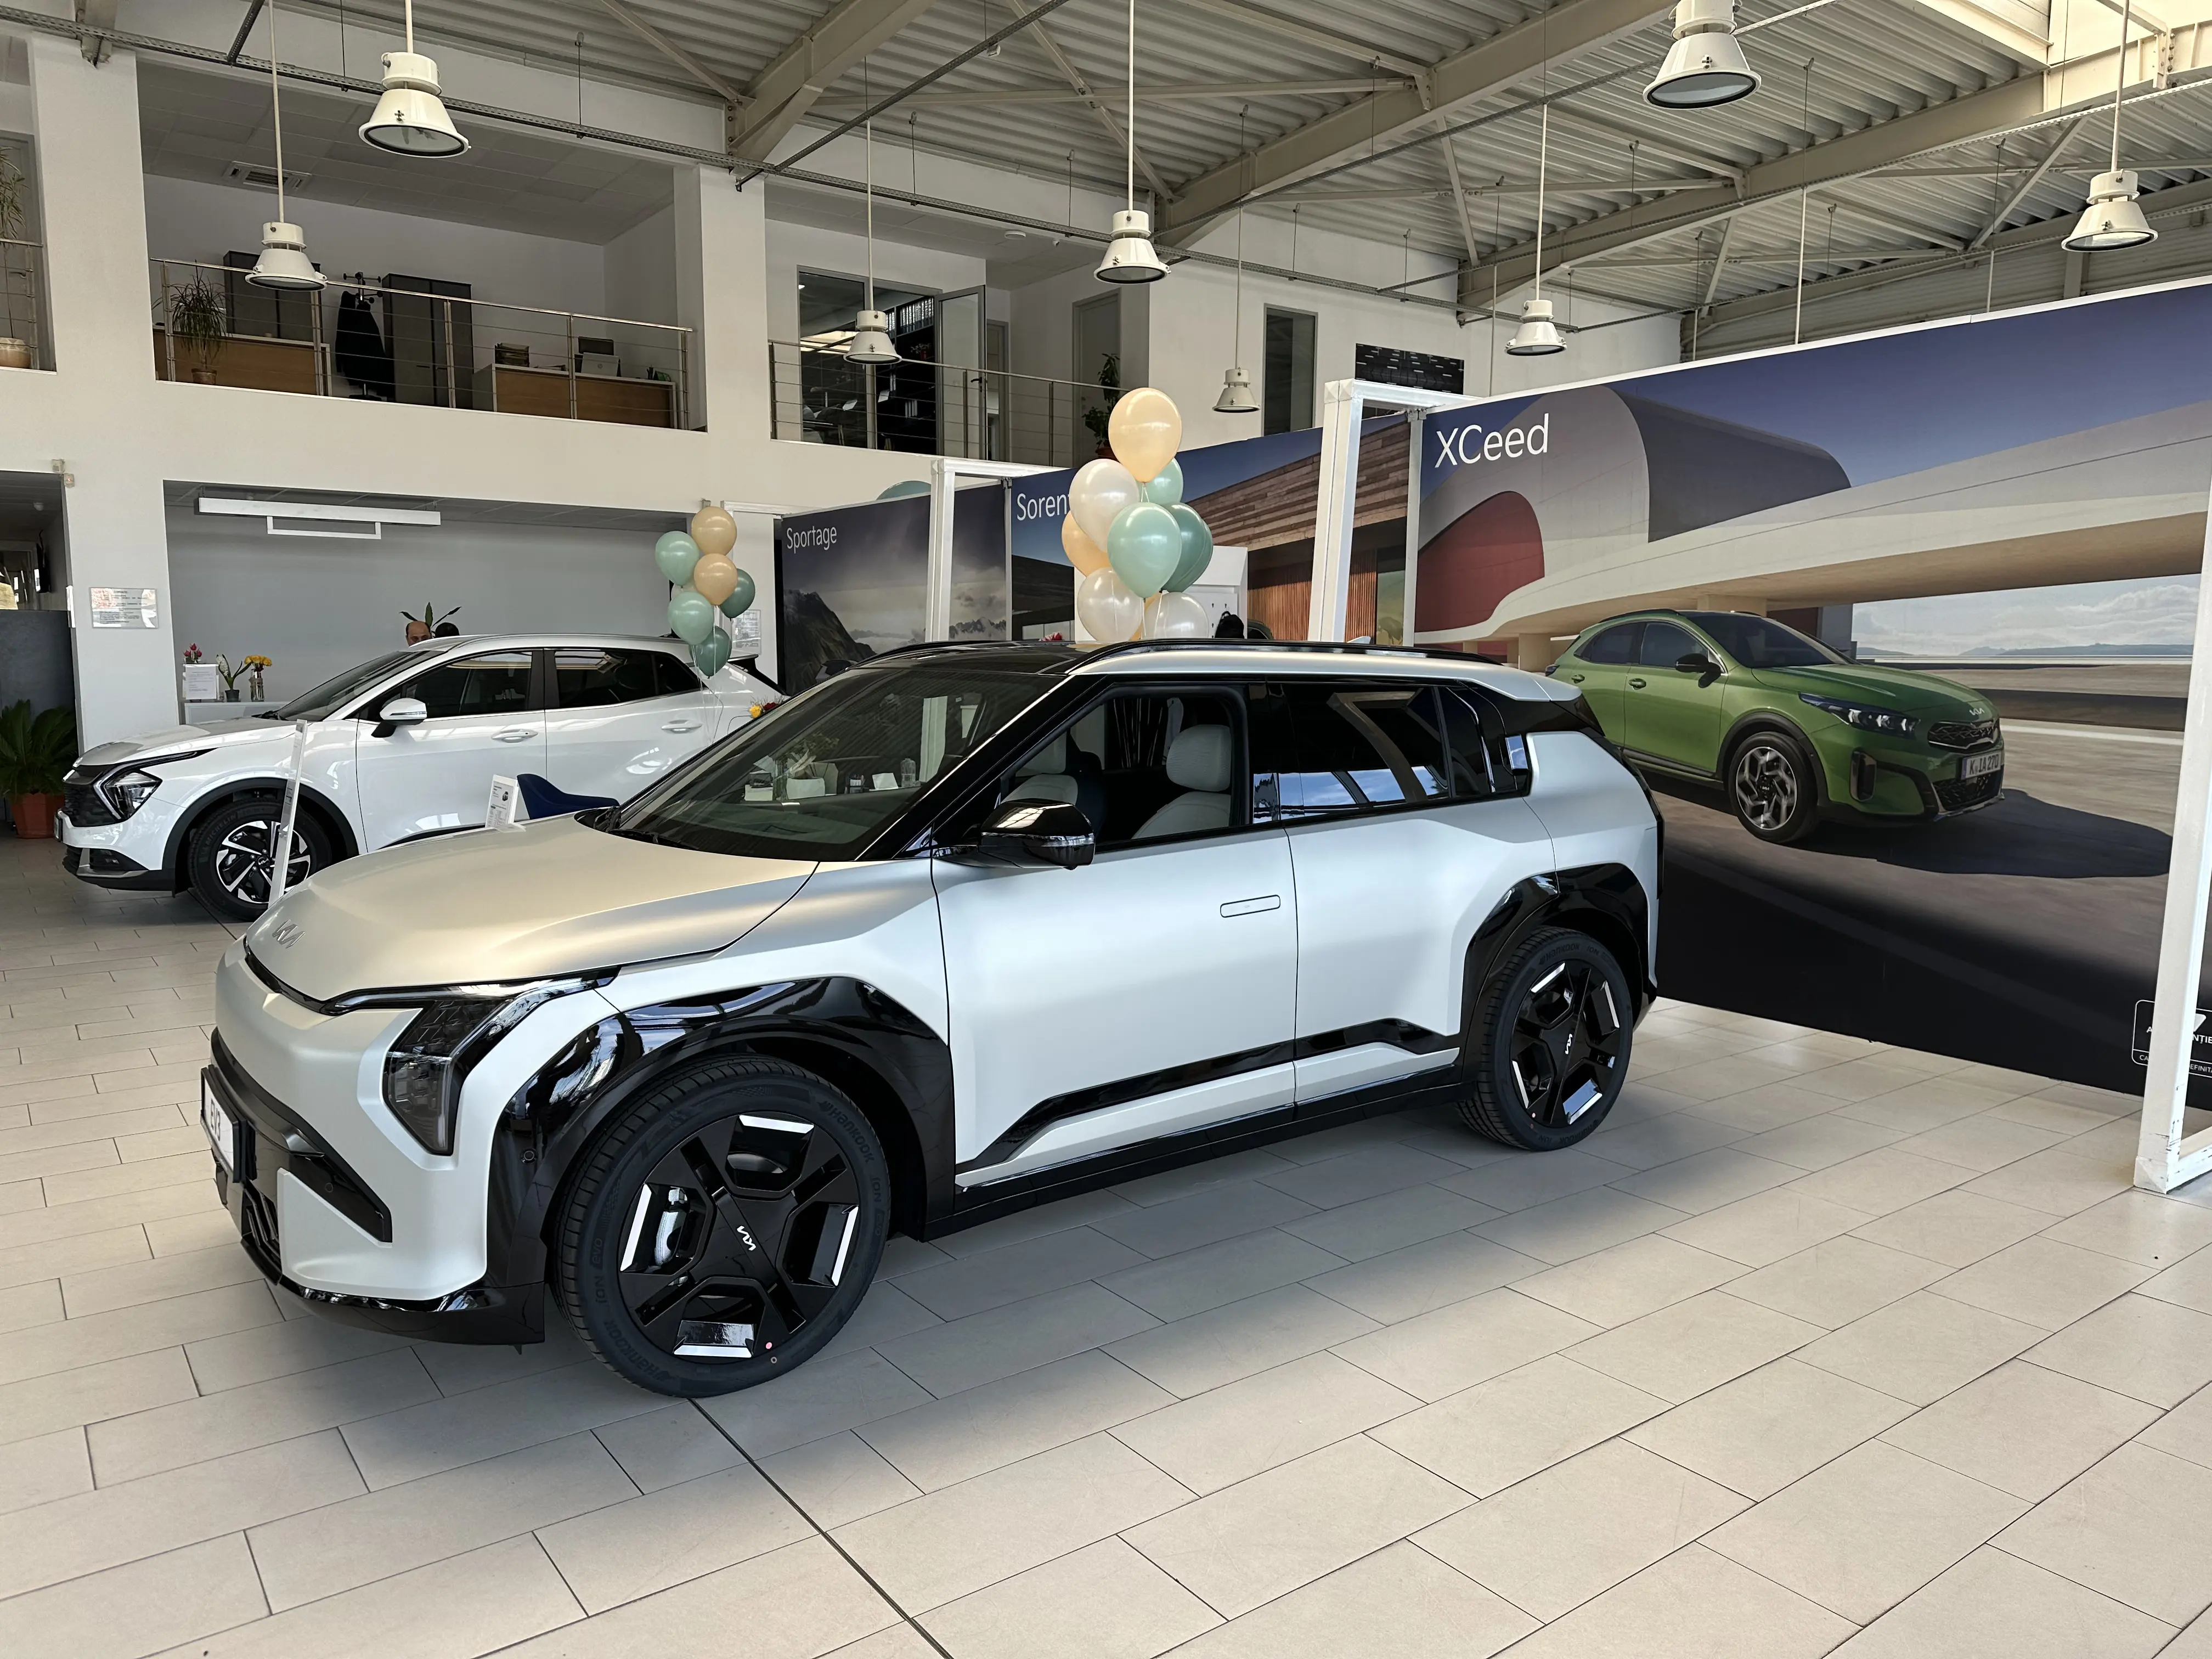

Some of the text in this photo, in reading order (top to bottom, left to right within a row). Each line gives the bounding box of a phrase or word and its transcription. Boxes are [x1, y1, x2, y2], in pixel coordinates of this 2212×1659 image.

[1434, 413, 1549, 468] XCeed
[1017, 493, 1069, 521] Soren
[786, 526, 837, 554] Sportage
[205, 812, 237, 847] MICHELIN
[210, 1098, 221, 1142] EV3
